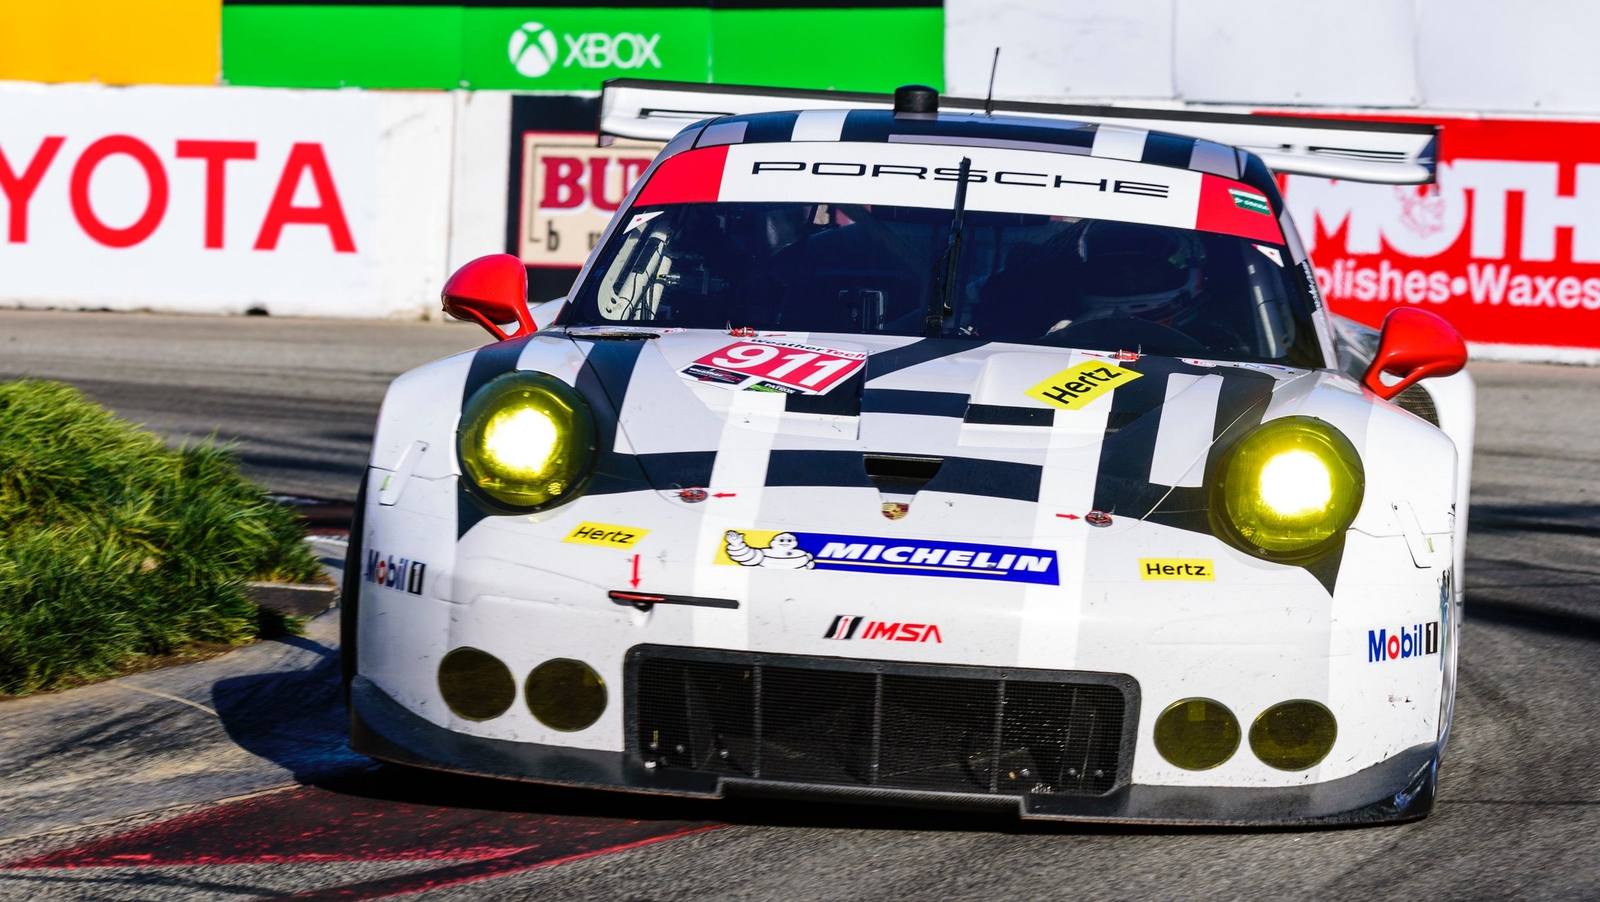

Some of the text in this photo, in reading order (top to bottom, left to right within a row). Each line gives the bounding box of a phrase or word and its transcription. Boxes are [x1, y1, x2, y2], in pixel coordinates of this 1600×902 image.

[562, 32, 662, 68] XBOX
[752, 161, 1170, 198] PORSCHE
[711, 344, 853, 387] 911
[1042, 365, 1122, 405] Hertz
[572, 526, 636, 544] Hertz
[366, 548, 408, 591] Mobil
[817, 542, 1053, 573] MICHELIN
[861, 620, 943, 644] IMSA
[1368, 624, 1423, 663] Mobil
